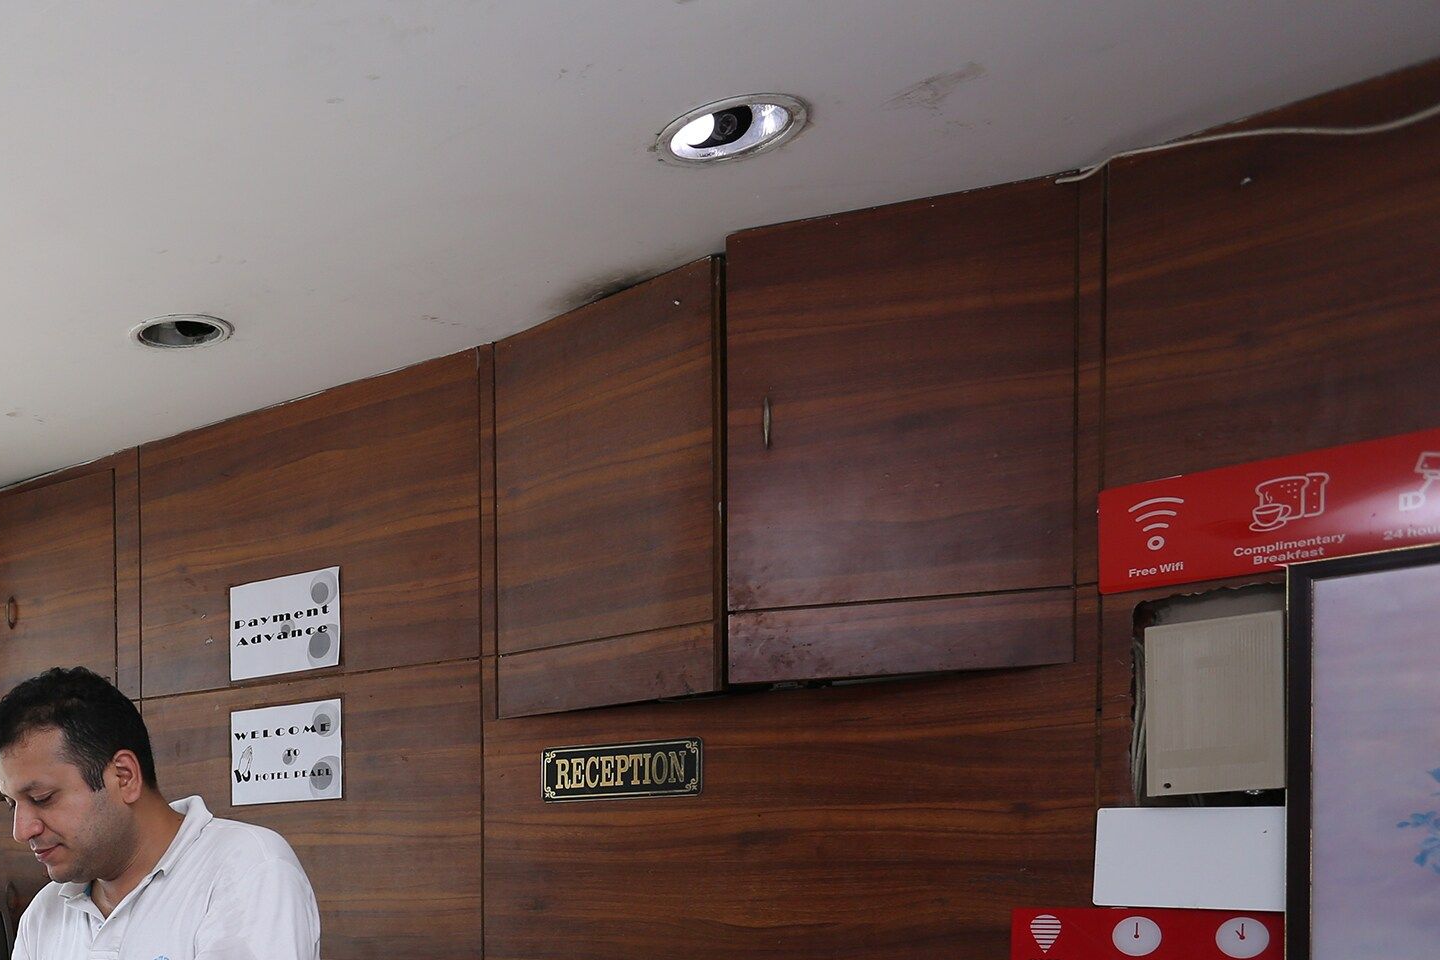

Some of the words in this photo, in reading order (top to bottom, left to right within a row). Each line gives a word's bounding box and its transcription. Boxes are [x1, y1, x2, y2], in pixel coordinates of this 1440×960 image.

[1383, 529, 1403, 540] 24
[1233, 533, 1345, 557] Complimentary
[1253, 546, 1325, 565] Breakfast
[1128, 566, 1157, 578] Free
[1159, 561, 1184, 573] Wifi
[236, 624, 328, 647] Advance
[234, 722, 331, 741] WELCOME
[286, 748, 300, 757] TO
[255, 771, 289, 782] HOTEL
[294, 768, 332, 778] PEARL
[555, 750, 687, 790] RECEPTION
